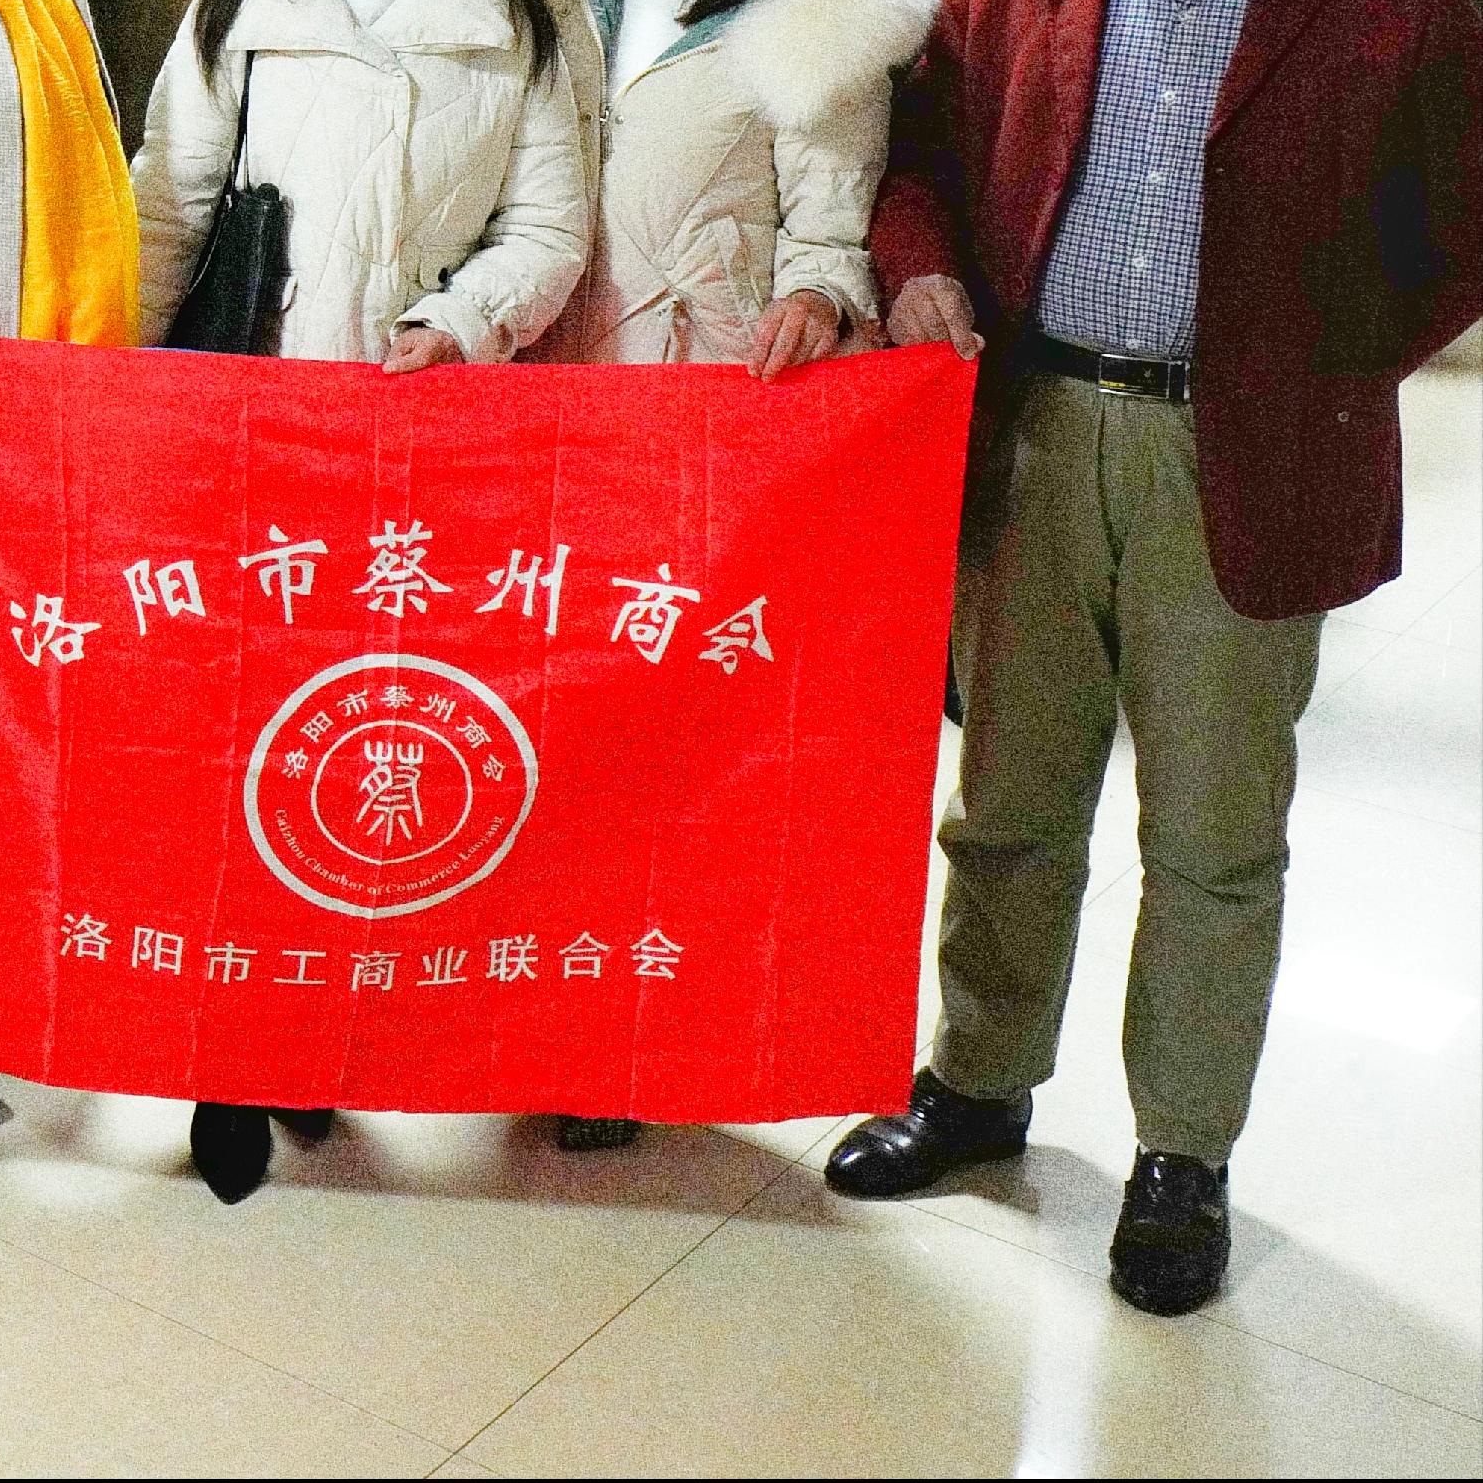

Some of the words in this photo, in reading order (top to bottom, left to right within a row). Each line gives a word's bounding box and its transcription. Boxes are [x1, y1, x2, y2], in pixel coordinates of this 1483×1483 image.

[10, 520, 774, 675] 洛阳市蔡州商会
[281, 686, 506, 782] 洛阳市蔡州商会
[275, 809, 305, 860] Caizhou
[305, 856, 364, 892] Chamber
[367, 884, 382, 895] of
[382, 860, 460, 894] Commerce
[461, 815, 505, 862] Luoyang
[60, 913, 684, 992] 洛阳市工商业联合会
